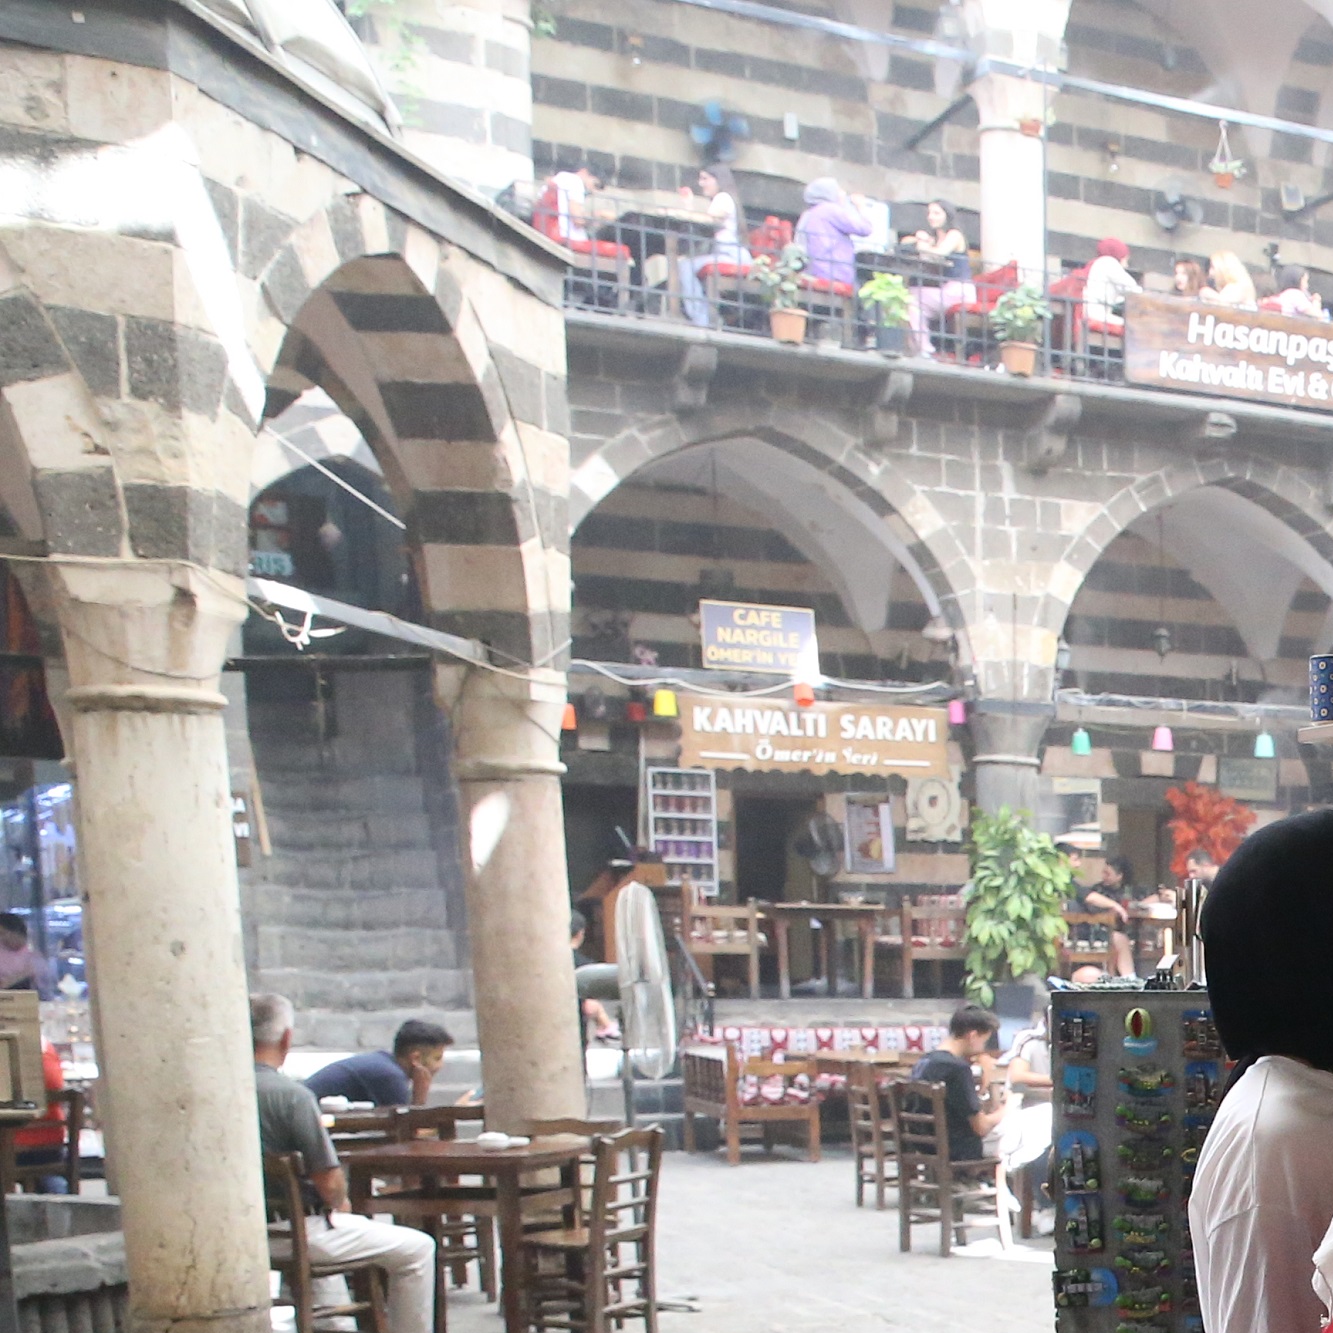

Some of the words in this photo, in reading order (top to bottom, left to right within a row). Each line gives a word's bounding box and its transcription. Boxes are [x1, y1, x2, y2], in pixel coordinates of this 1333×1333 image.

[1267, 366, 1305, 397] Evi
[1307, 372, 1328, 400] &
[733, 608, 783, 630] CAFE
[693, 705, 828, 738] KAHVALTI
[840, 716, 938, 743] SARAYI
[755, 738, 838, 764] Ömer'in
